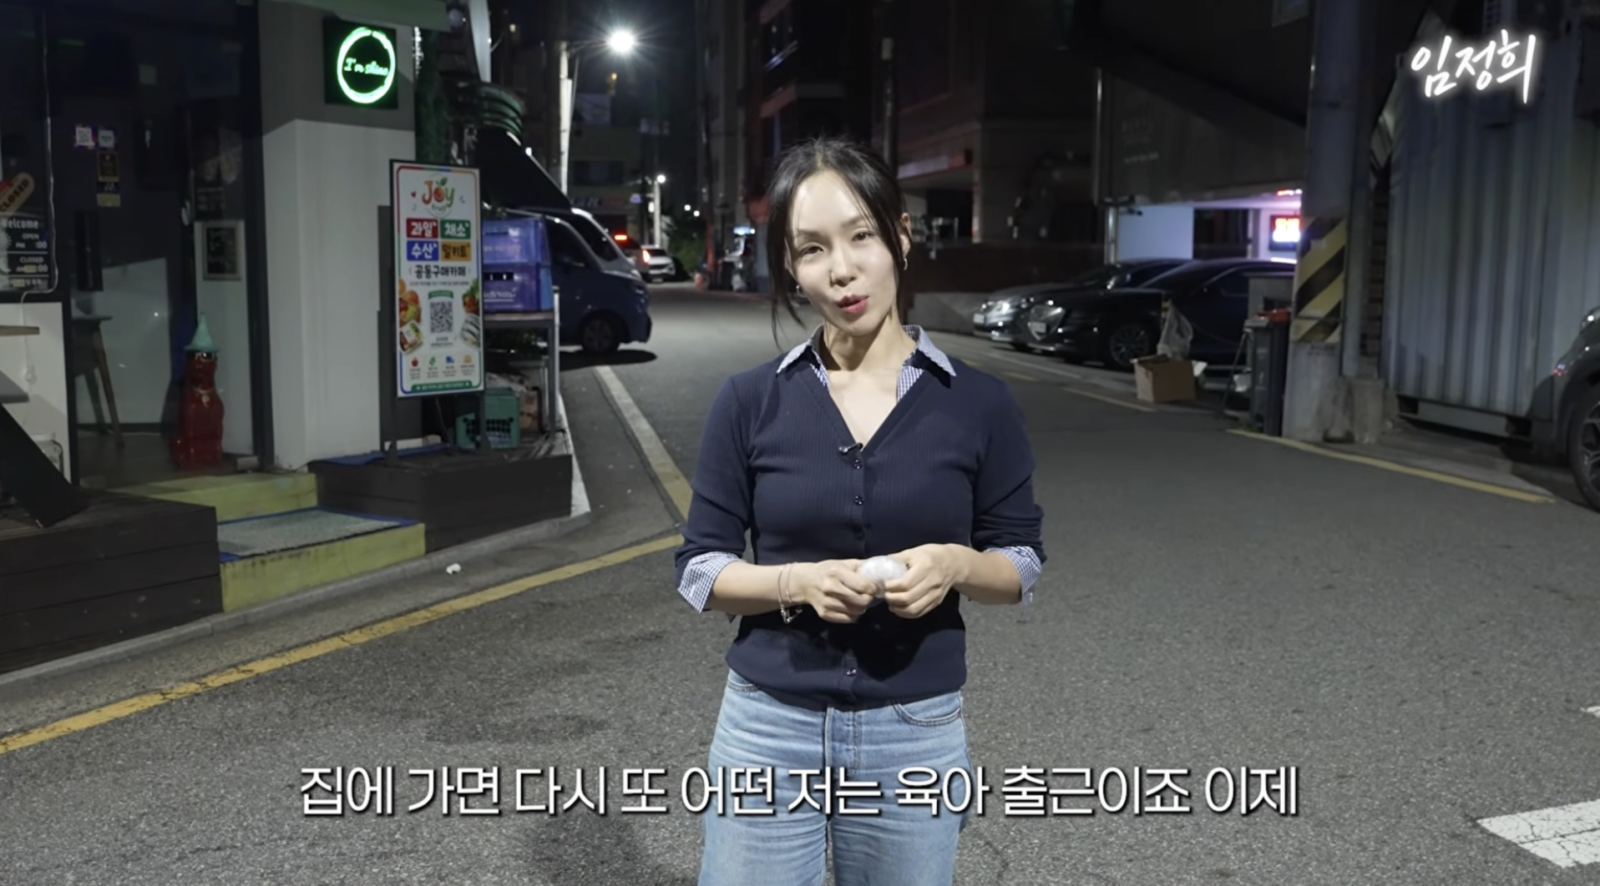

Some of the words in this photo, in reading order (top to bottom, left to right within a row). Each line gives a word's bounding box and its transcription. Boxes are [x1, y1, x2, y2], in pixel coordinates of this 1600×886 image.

[0, 179, 29, 212] CLOSED
[410, 221, 434, 238] 과일
[444, 222, 466, 238] 채소
[411, 243, 434, 259] 수산
[415, 265, 466, 279] 공동구매카페
